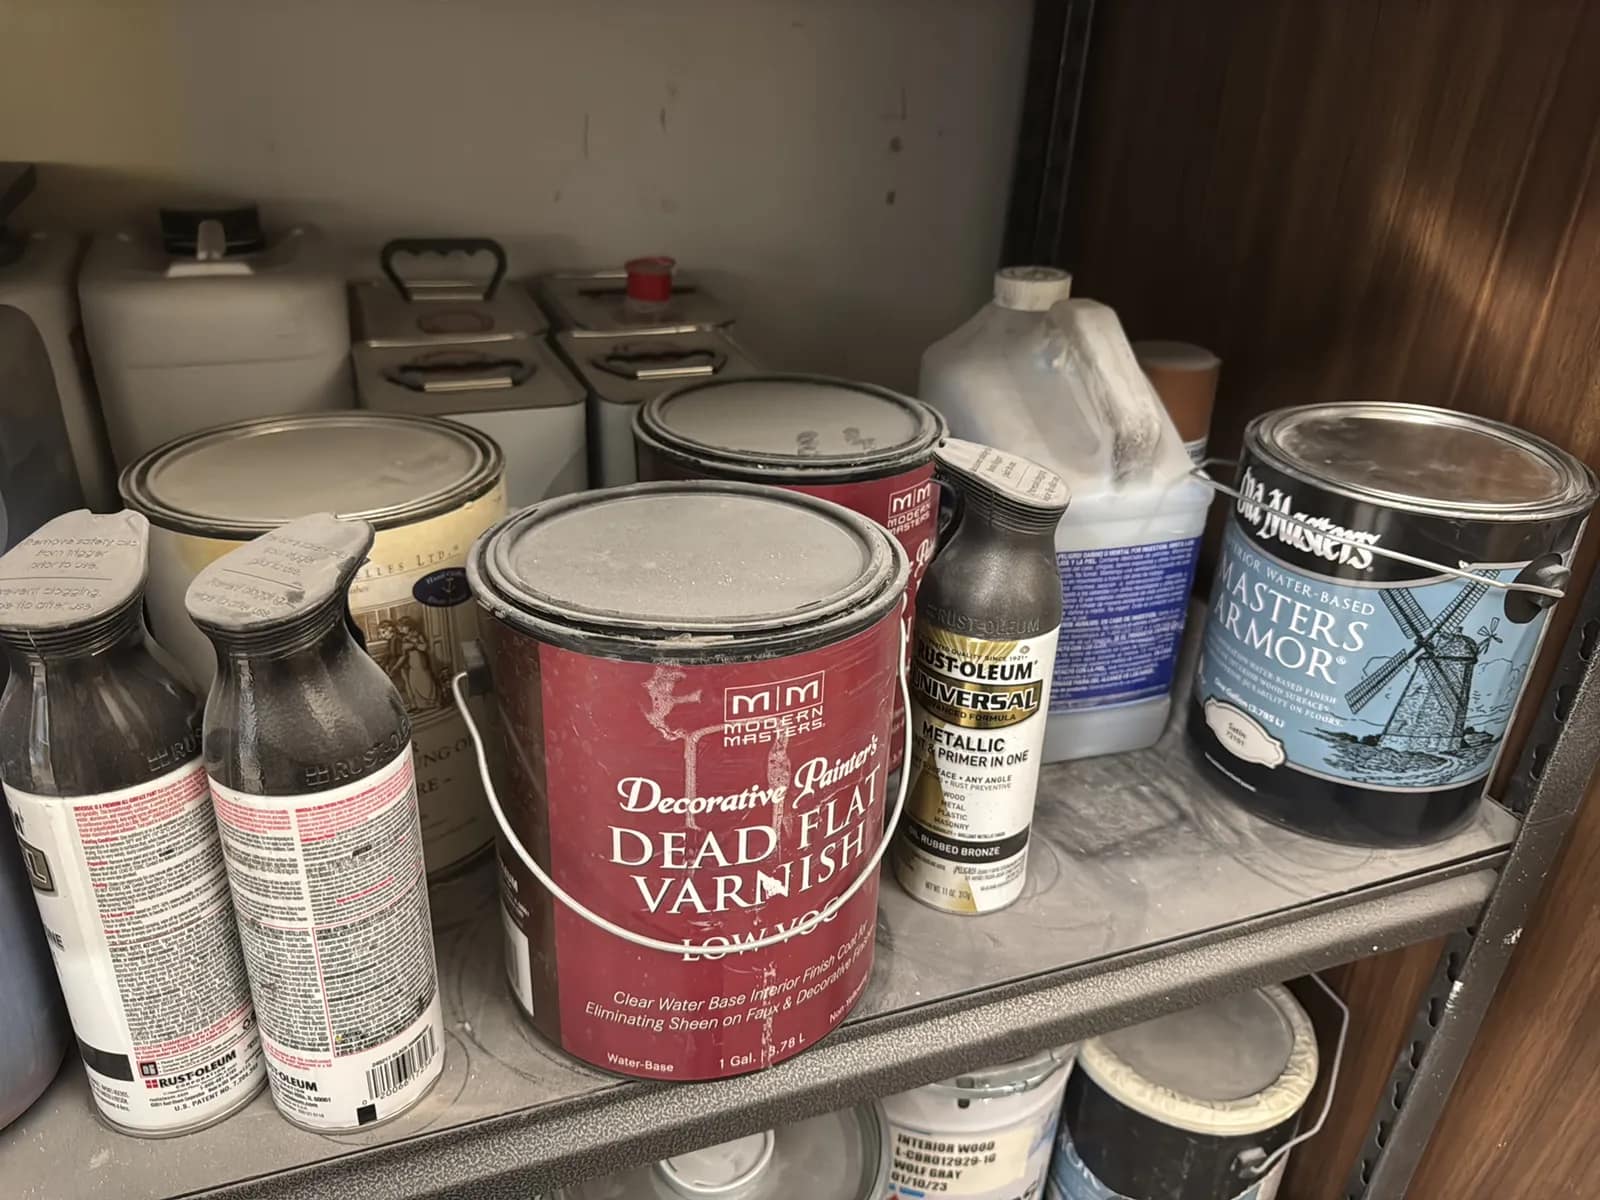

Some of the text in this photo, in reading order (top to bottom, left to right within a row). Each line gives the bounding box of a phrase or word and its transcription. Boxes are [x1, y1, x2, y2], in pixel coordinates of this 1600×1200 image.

[1218, 550, 1369, 653] MASTERS
[1266, 566, 1375, 616] WATER-BASED
[914, 668, 1039, 713] UNIVERSAL
[723, 705, 824, 735] MODERN
[968, 712, 1018, 722] FORMULA
[922, 720, 1006, 753] METALLIC
[938, 747, 988, 768] PRIMER
[990, 755, 1004, 768] IN
[1006, 749, 1030, 766] ONE
[616, 734, 879, 816] Decorative Painter's
[965, 775, 984, 784] ANY
[984, 774, 1013, 784] ANGLE
[969, 782, 1013, 792] PREVENTIVE
[941, 800, 967, 812] METAL
[943, 791, 967, 802] WOOD
[607, 763, 881, 870] DEAD FLAT
[934, 816, 970, 831] MASONRY
[937, 808, 968, 821] PLASTIC
[920, 834, 960, 855] RUBBED
[960, 846, 1001, 858] BRONZE
[630, 821, 866, 915] VARNISH
[680, 927, 768, 962] LOW
[585, 1000, 665, 1032] Eliminating
[668, 1015, 719, 1031] Sheen
[722, 1013, 743, 1027] on
[745, 1002, 780, 1024] Faux
[782, 995, 793, 1011] &
[796, 956, 853, 1006] Decorative
[613, 990, 655, 1009] Clear
[658, 997, 703, 1013] Water
[708, 992, 746, 1011] Base
[750, 975, 801, 1002] Interior
[802, 954, 836, 984] Finish
[606, 1052, 674, 1073] Water-Base
[719, 1058, 725, 1070] 1
[729, 1051, 757, 1068] Gal.
[798, 1031, 806, 1044] L
[159, 1050, 237, 1089] RUST-OLEUM
[191, 1092, 219, 1107] PATENT
[219, 1085, 232, 1095] NO.
[897, 1133, 996, 1153] INTERIOR WOOD
[890, 1170, 948, 1192] 01/10/23
[893, 1158, 963, 1180] WOLF GRAY
